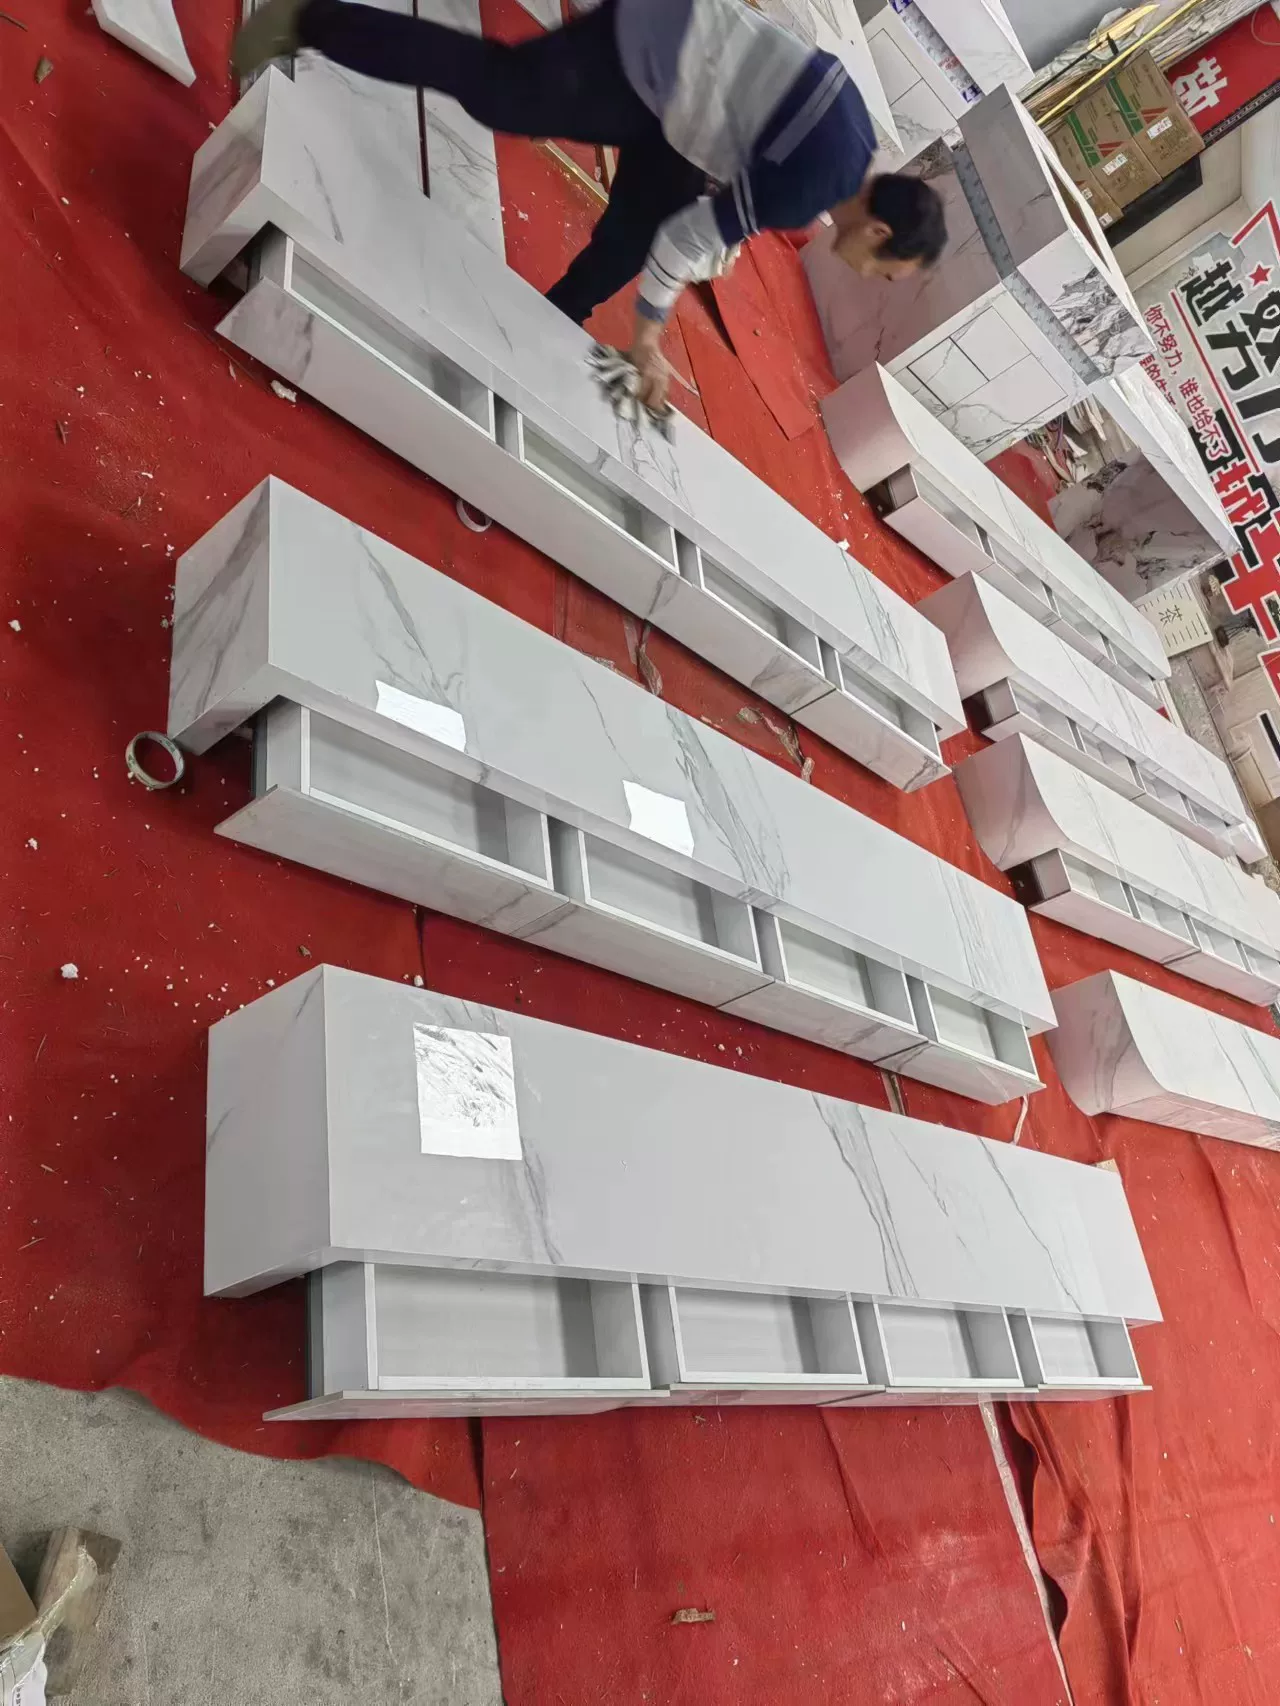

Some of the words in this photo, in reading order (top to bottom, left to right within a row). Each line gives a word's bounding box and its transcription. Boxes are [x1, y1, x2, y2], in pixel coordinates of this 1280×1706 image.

[1144, 304, 1231, 459] 你不努力，谁也给不了
[1158, 604, 1183, 628] 茶
